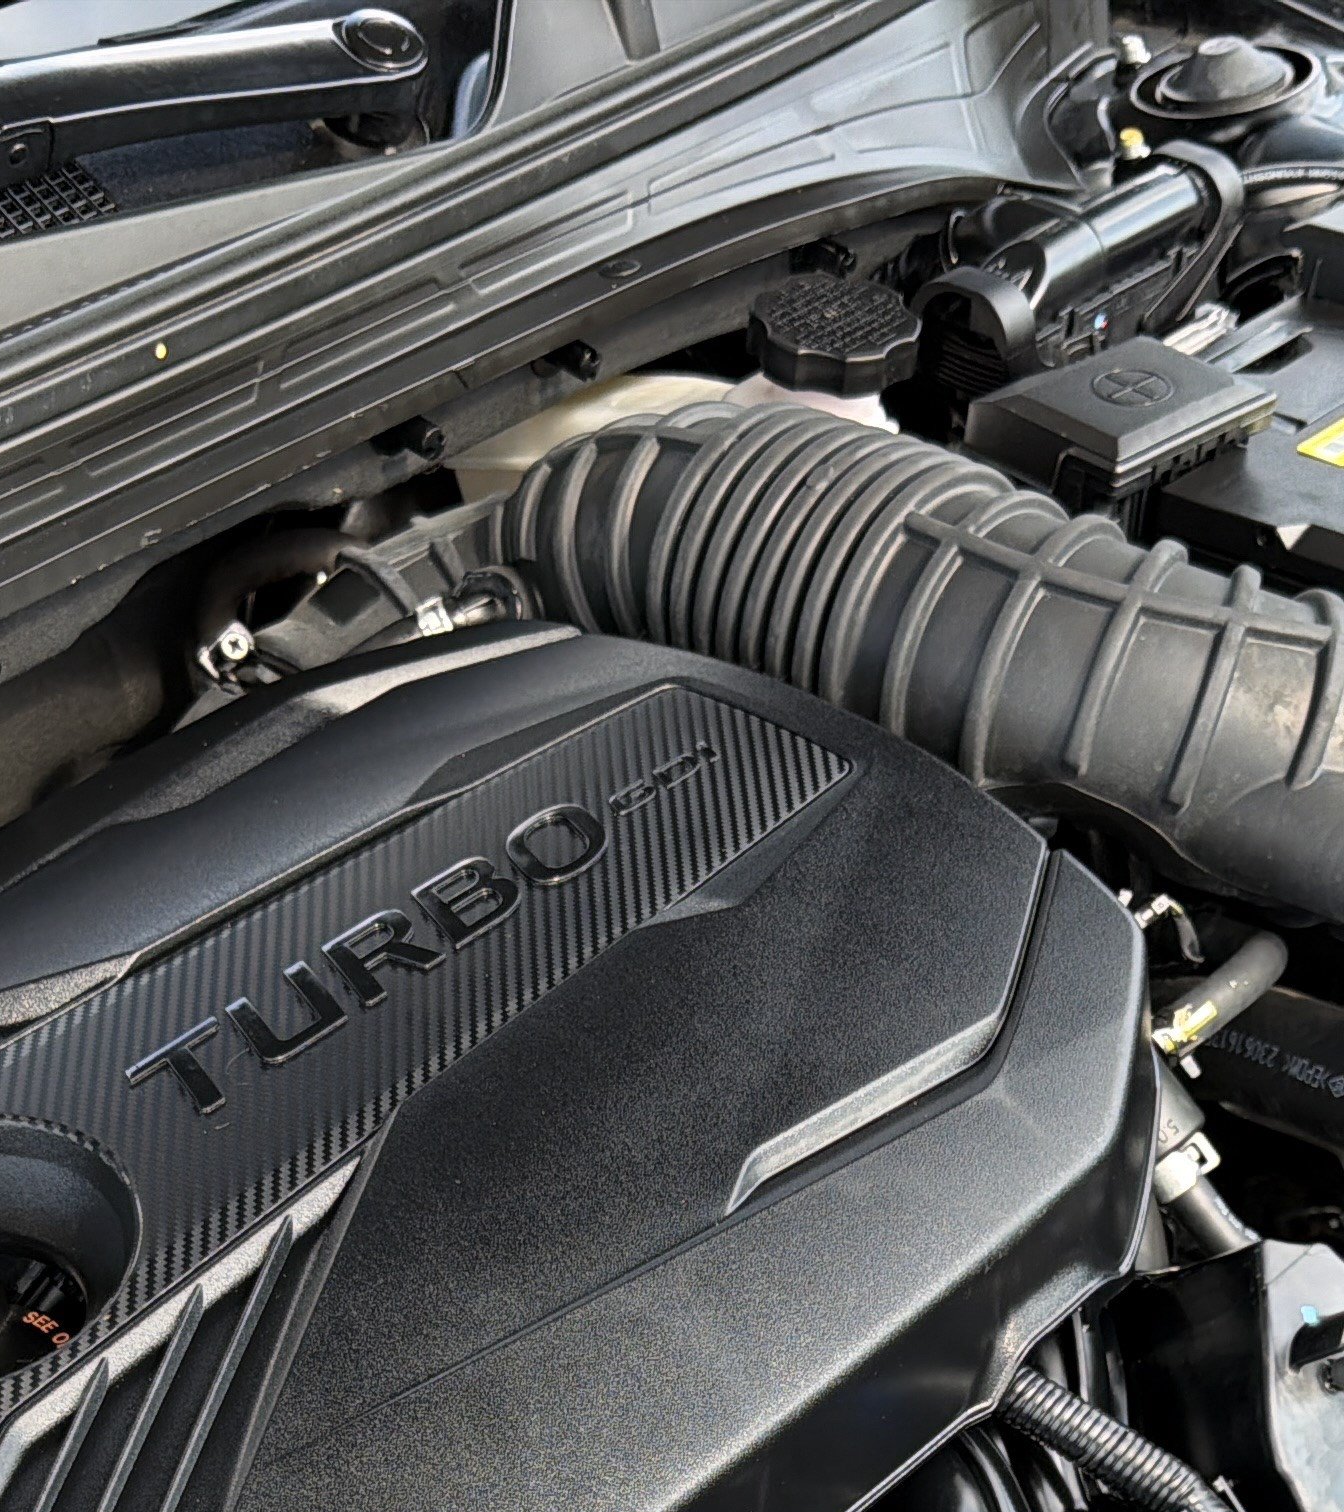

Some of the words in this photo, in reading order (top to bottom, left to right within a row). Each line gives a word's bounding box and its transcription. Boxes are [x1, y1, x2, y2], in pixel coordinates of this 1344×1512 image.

[124, 803, 610, 1116] TURBO
[608, 742, 720, 817] GDI
[22, 1311, 60, 1334] SEE
[51, 1331, 70, 1349] O
